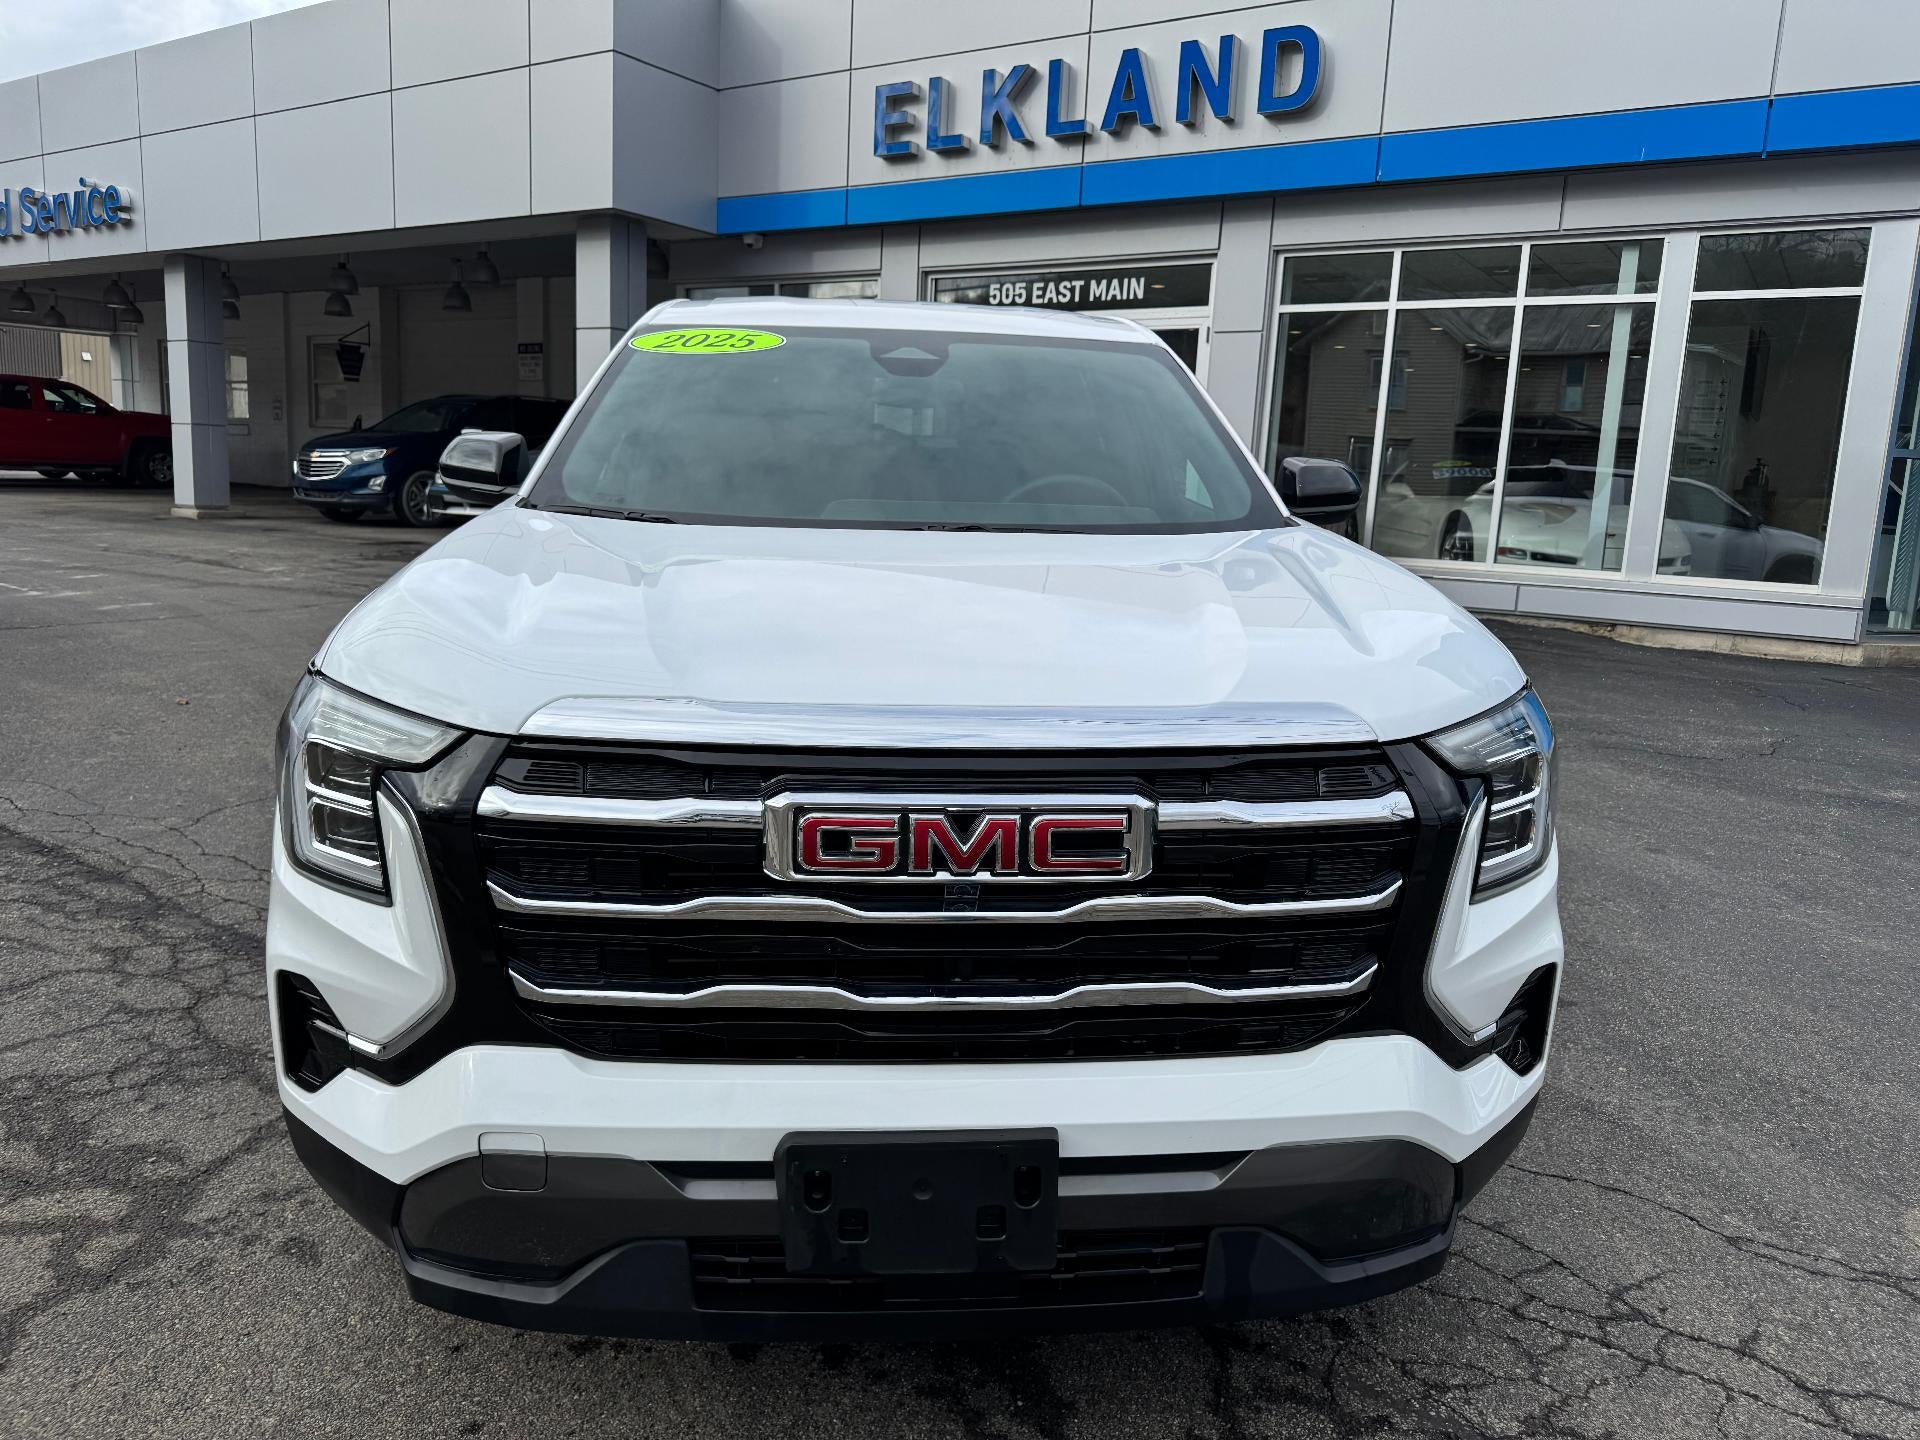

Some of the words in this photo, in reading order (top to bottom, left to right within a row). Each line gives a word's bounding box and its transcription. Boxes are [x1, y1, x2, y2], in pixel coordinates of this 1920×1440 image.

[874, 25, 1323, 159] ELKLAND
[20, 177, 122, 234] Service
[989, 282, 1027, 305] 505
[1031, 280, 1085, 304] EAST
[1089, 277, 1145, 302] MAIN
[653, 333, 762, 349] 2025
[798, 812, 1129, 874] GMC
